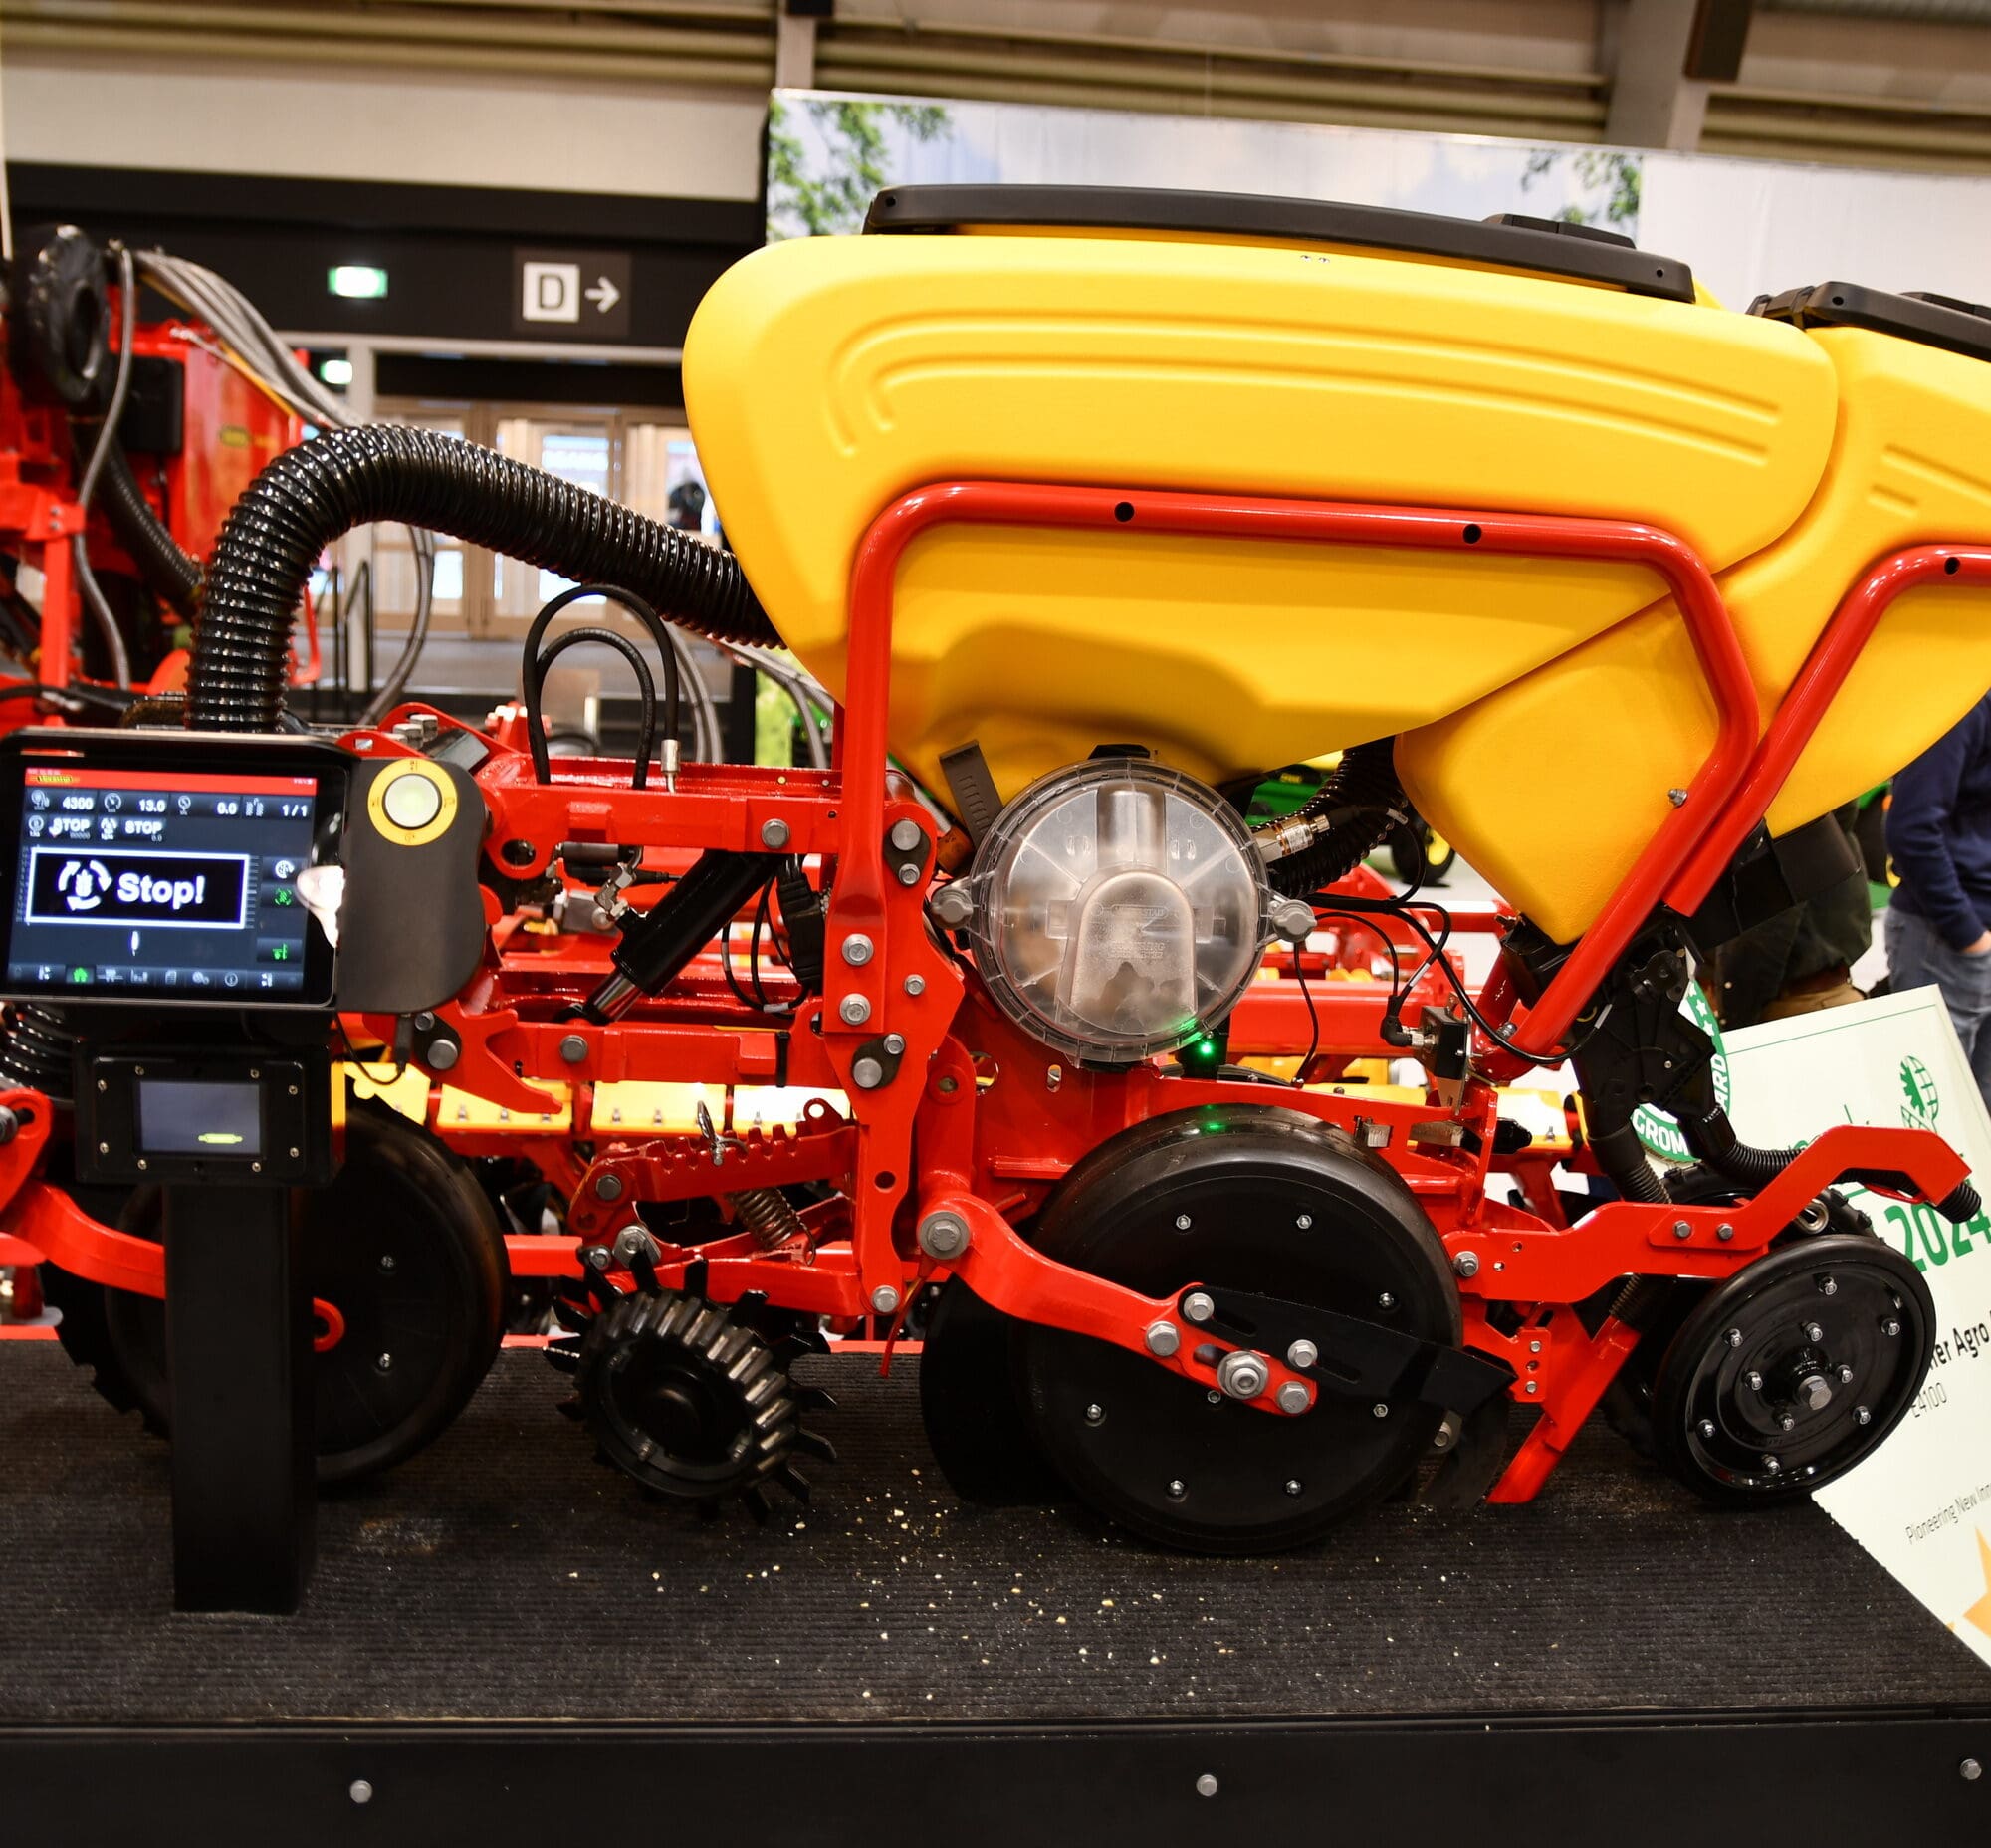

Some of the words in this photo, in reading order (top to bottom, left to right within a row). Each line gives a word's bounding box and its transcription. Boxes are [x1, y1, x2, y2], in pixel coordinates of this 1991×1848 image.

[539, 274, 564, 310] D
[138, 799, 166, 812] 13.0
[217, 802, 237, 815] 0.0
[124, 820, 162, 835] STOP
[117, 872, 205, 910] Stop!
[1710, 1053, 1729, 1114] ARD
[1632, 1108, 1690, 1156] GROM
[1952, 1322, 1989, 1358] Agro
[1905, 1504, 1958, 1545] Pioneering
[1954, 1493, 1977, 1514] New
[1975, 1484, 1991, 1503] Inn
